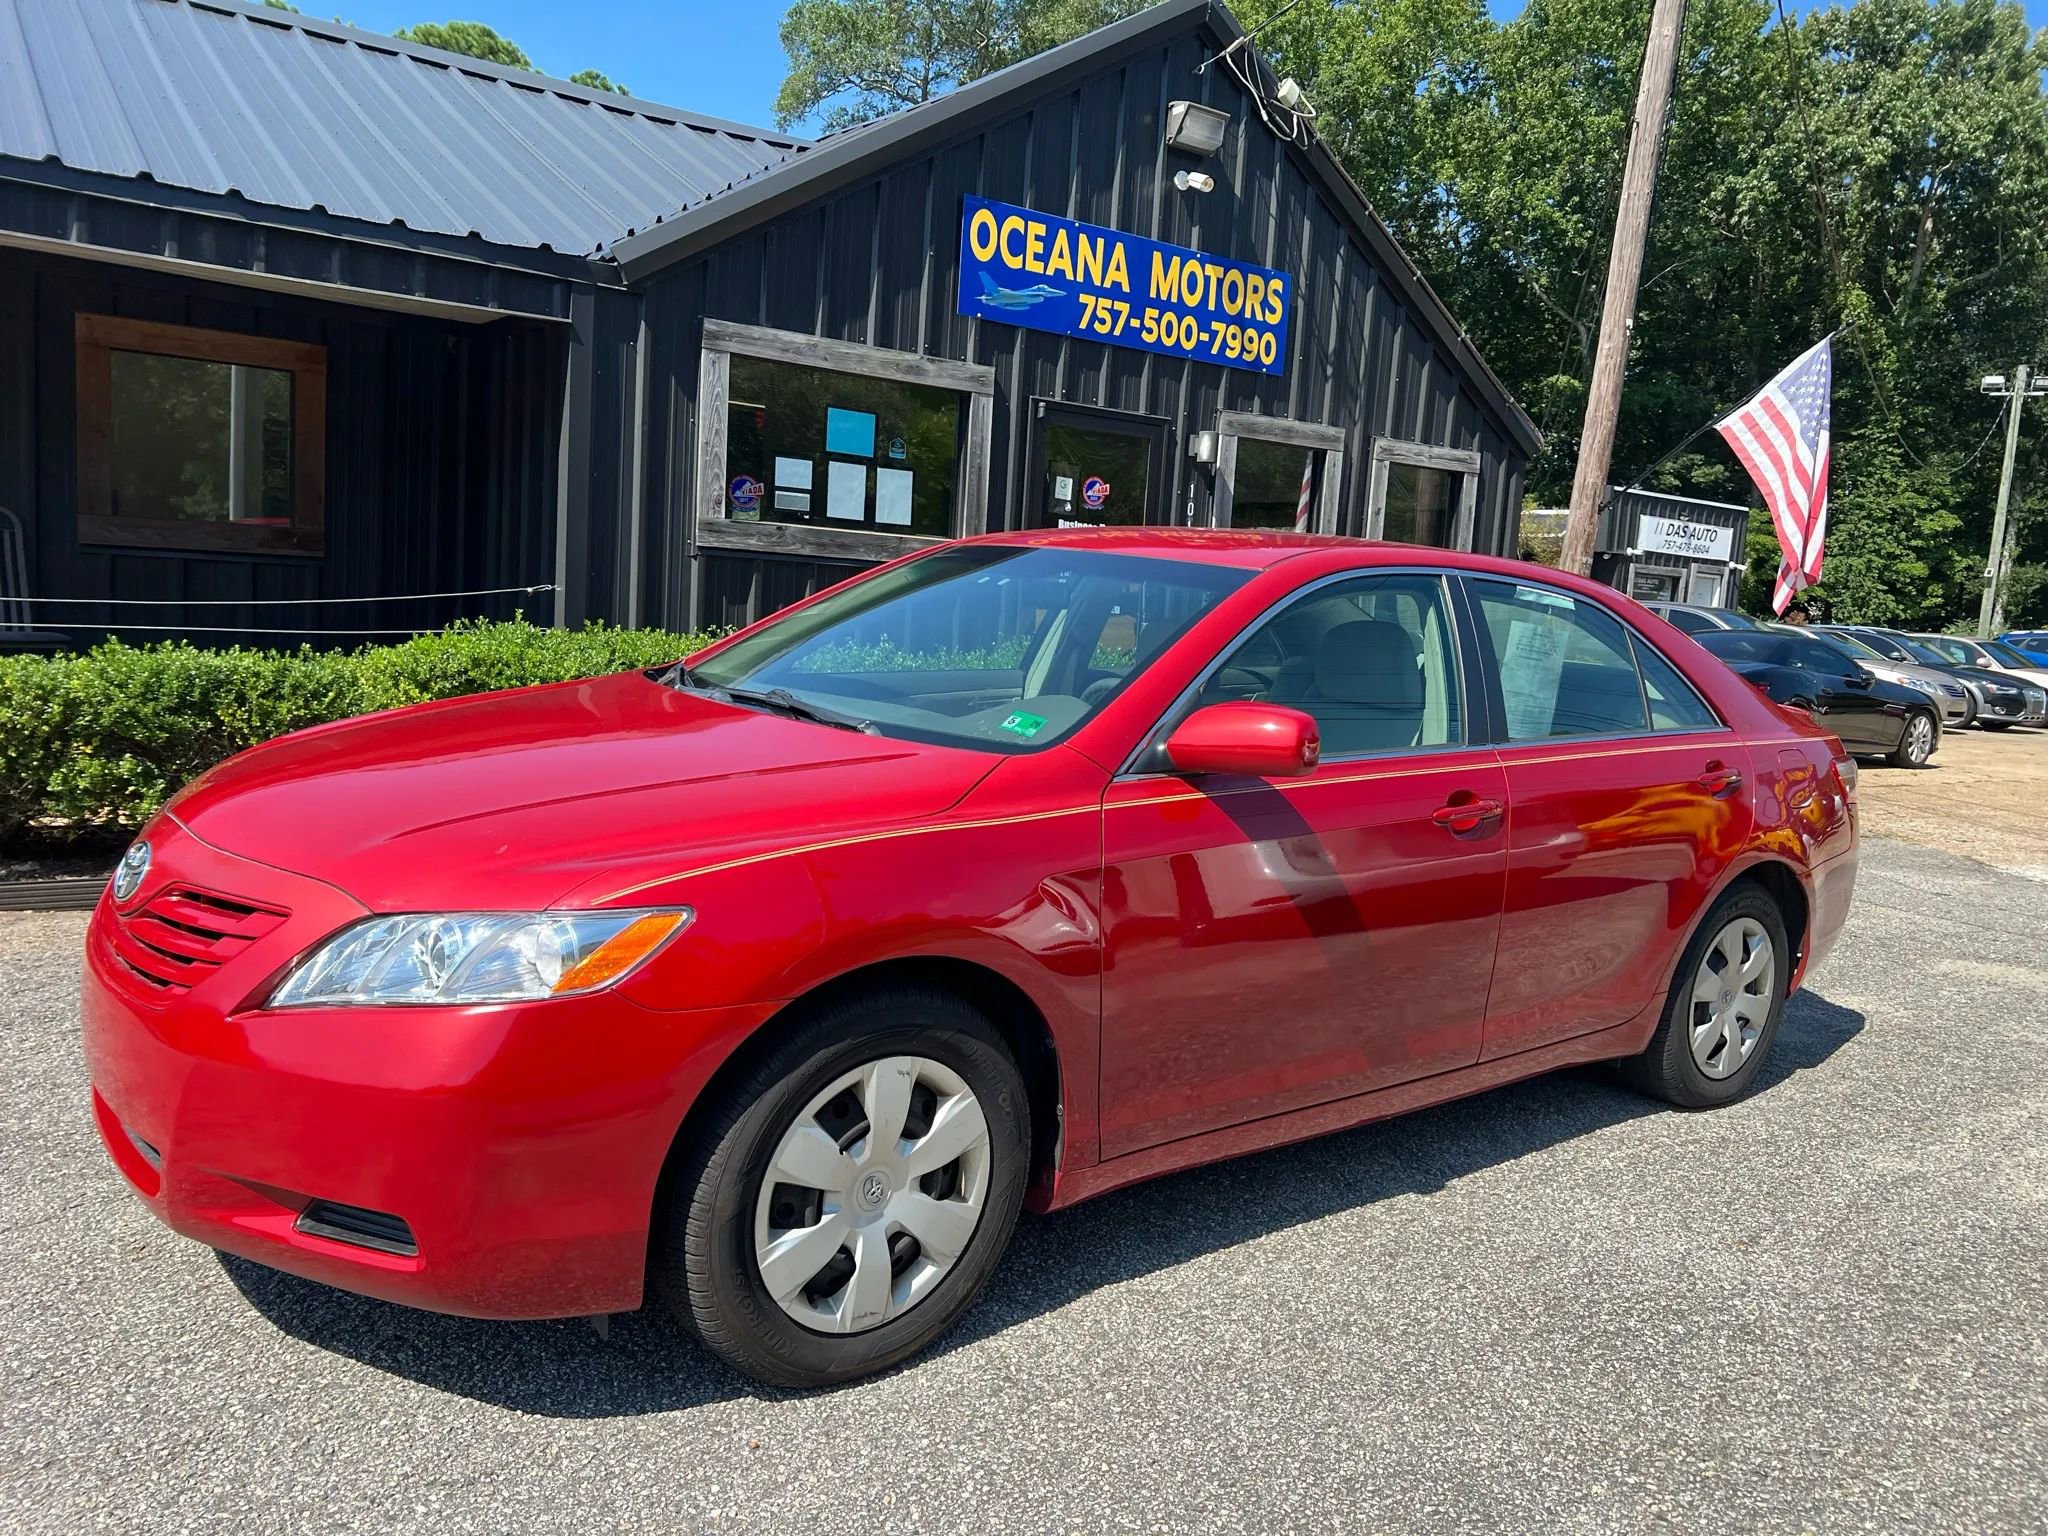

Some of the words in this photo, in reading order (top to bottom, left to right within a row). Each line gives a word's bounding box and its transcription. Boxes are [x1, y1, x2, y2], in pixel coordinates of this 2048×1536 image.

[969, 208, 1130, 293] OCEANA
[1149, 251, 1283, 325] MOTORS
[1078, 293, 1277, 365] 757-500-7990
[1666, 523, 1689, 538] DAS
[1689, 527, 1718, 543] AUTO
